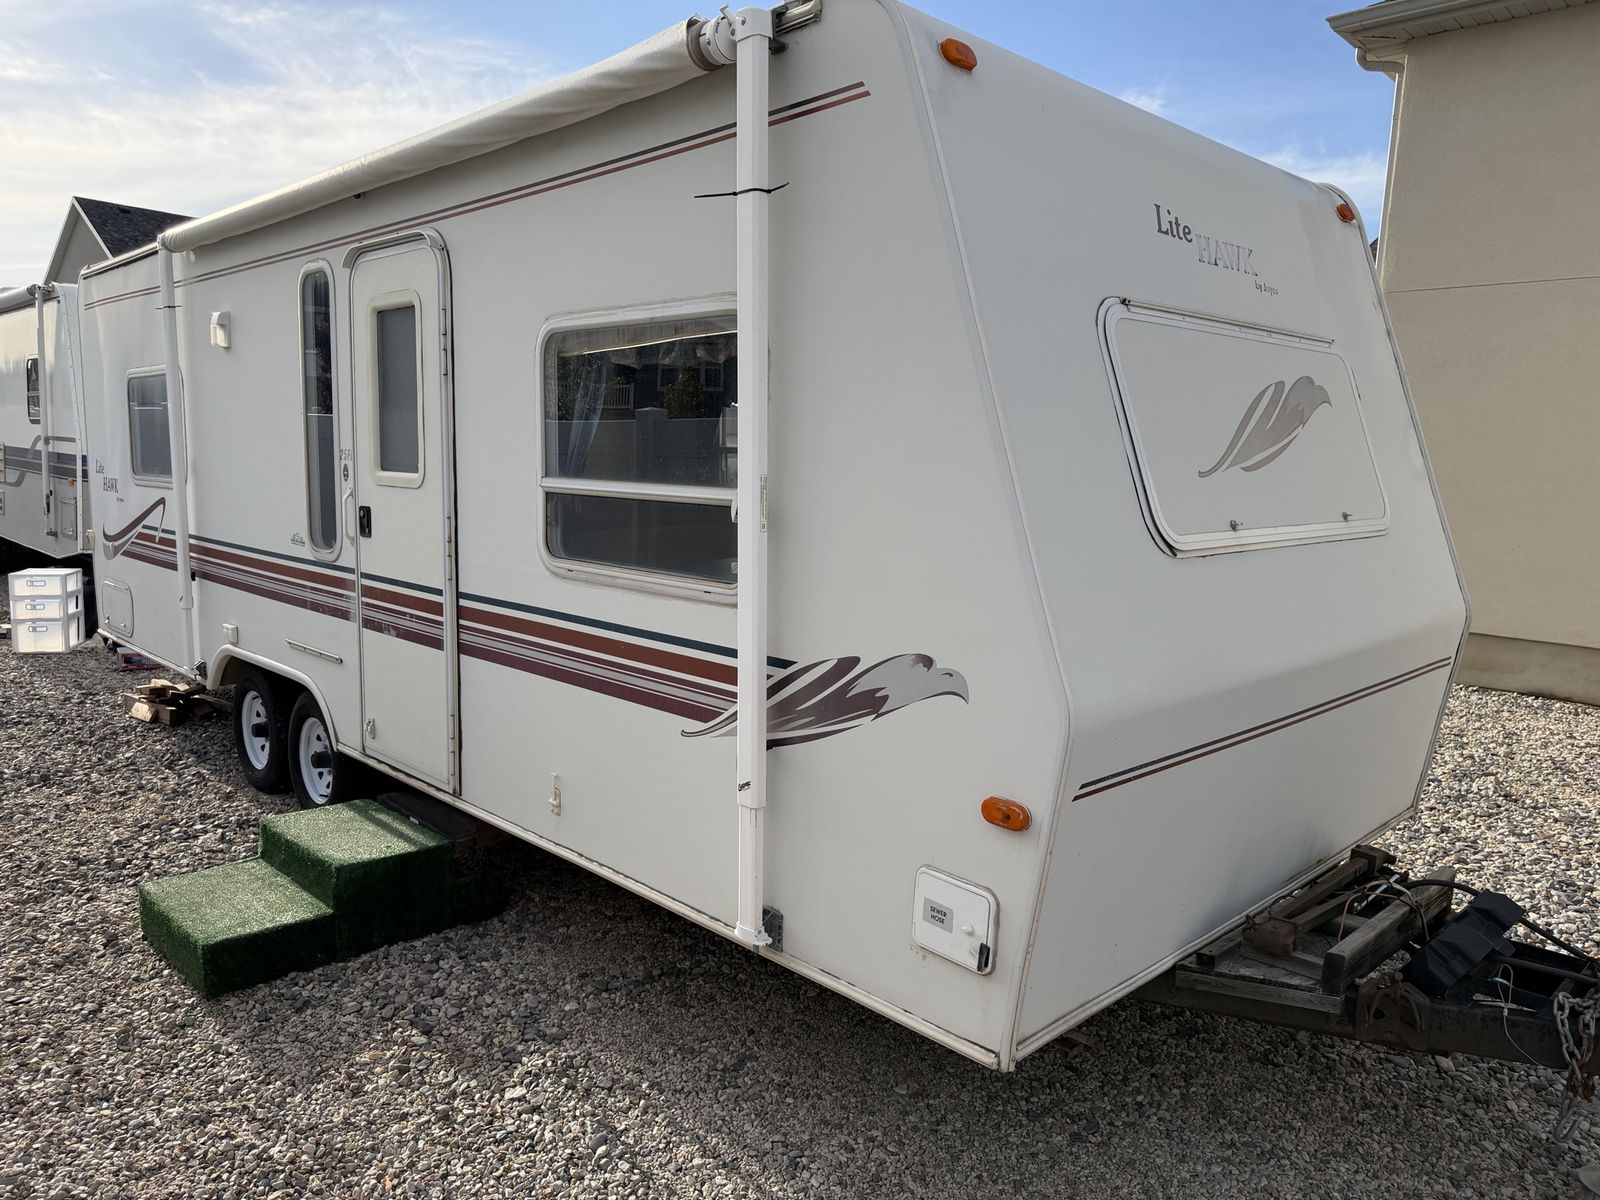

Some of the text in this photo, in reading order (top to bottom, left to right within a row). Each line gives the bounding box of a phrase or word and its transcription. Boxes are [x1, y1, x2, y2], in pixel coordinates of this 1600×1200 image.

[1154, 203, 1193, 243] Lite
[1195, 233, 1259, 277] HAWK
[95, 458, 105, 474] Lite
[103, 476, 119, 494] HAWK
[930, 905, 947, 918] SEWER
[930, 914, 945, 925] HOSE
